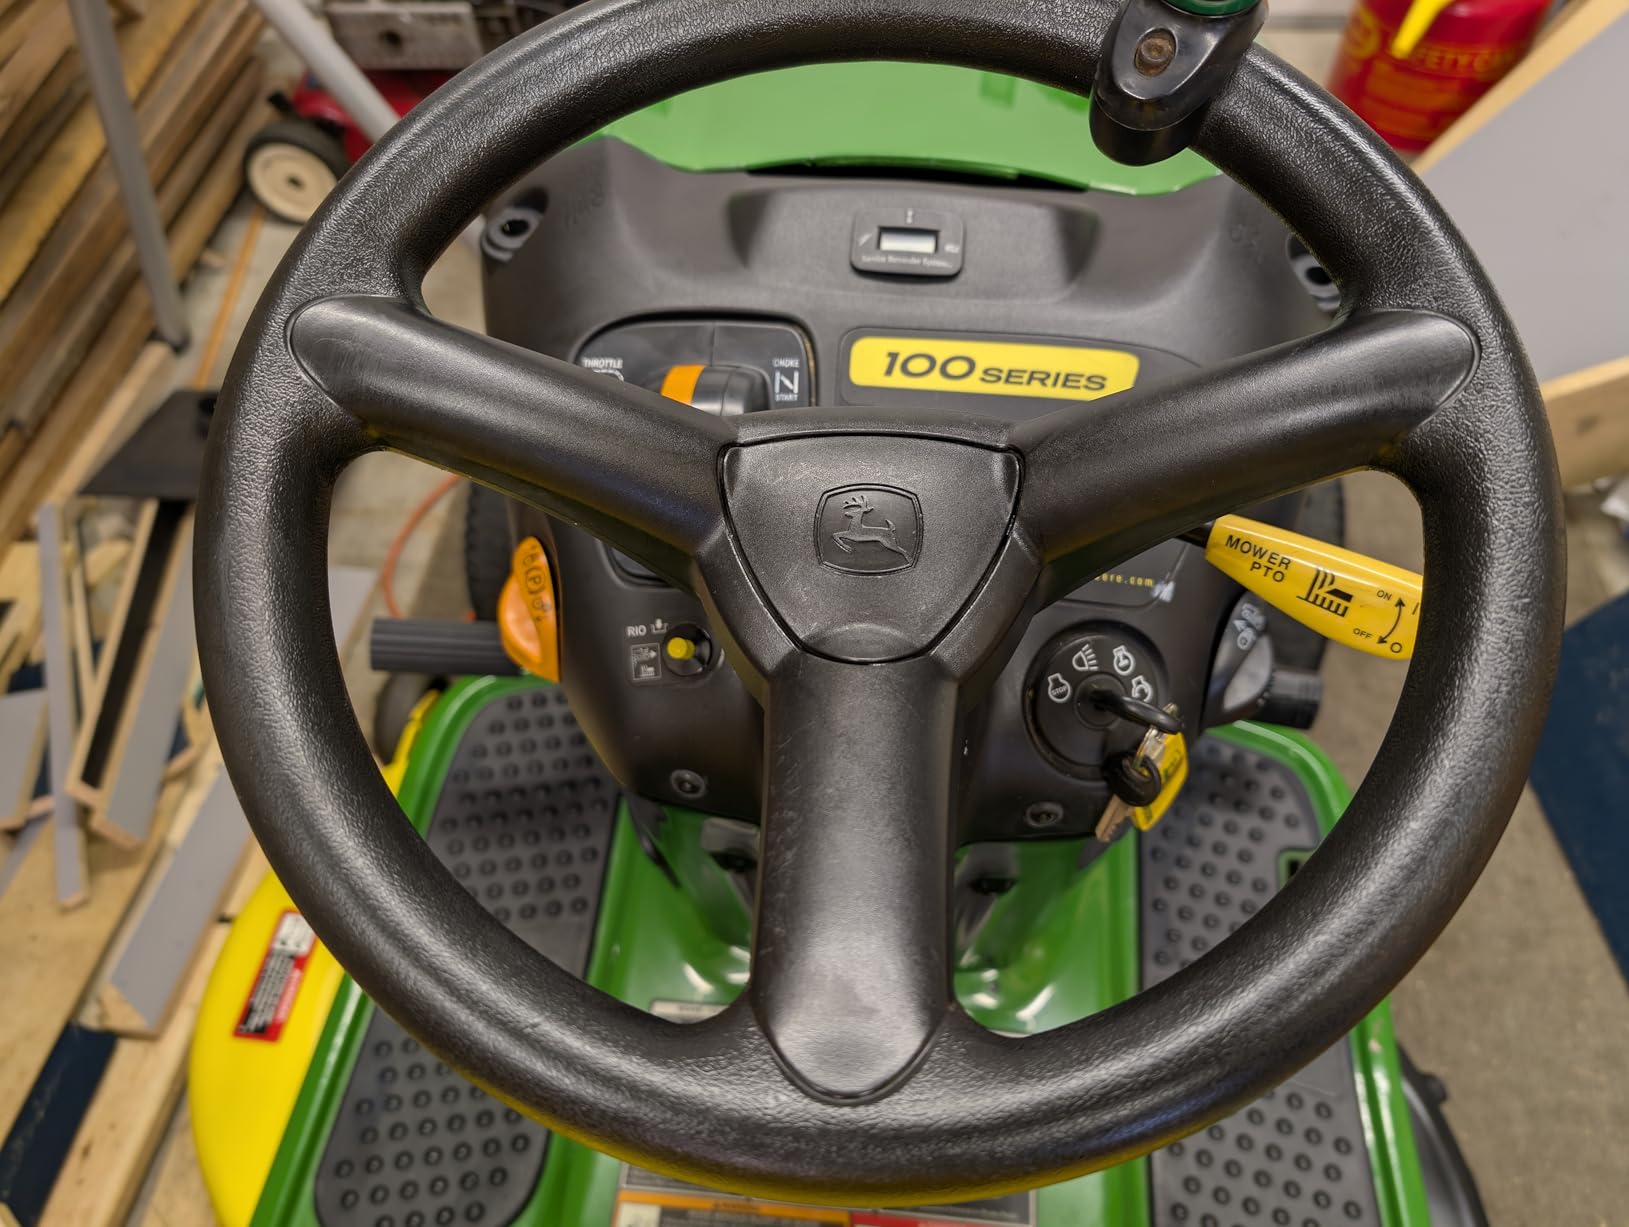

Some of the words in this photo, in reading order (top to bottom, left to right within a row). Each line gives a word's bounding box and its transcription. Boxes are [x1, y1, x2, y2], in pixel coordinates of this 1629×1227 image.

[582, 357, 623, 369] THROTTLE
[772, 358, 800, 368] CHOKE
[883, 352, 976, 380] 100
[980, 367, 1107, 391] SERIES
[1225, 534, 1291, 570] MOWER
[1249, 561, 1285, 582] PTO
[1376, 590, 1392, 601] ON
[627, 625, 647, 637] RIO
[1352, 628, 1373, 639] OFF
